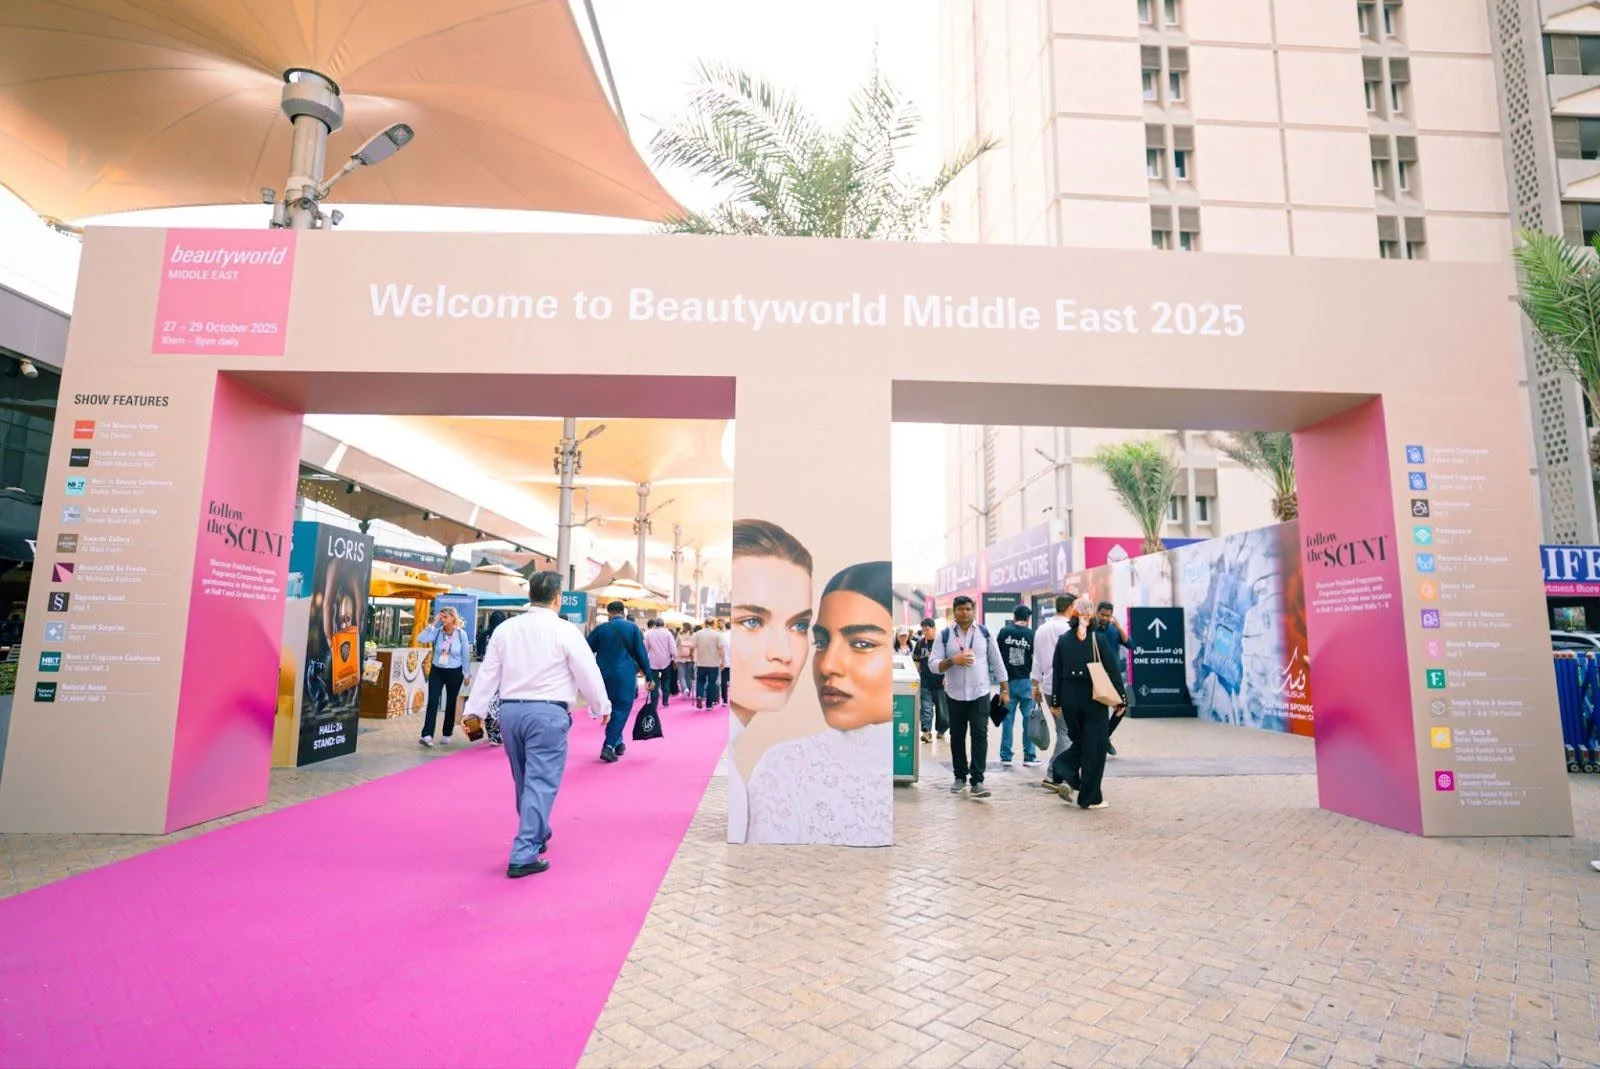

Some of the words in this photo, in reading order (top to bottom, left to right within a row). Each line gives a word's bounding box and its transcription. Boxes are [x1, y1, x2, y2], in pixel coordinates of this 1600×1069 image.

[170, 244, 288, 268] beautyworld
[168, 269, 209, 280] MIDDLE
[211, 270, 239, 280] EAST
[370, 283, 558, 319] Welcome
[573, 290, 612, 320] to
[629, 288, 886, 331] Beautyworld
[904, 294, 1040, 329] Middle
[1056, 298, 1138, 333] East
[1151, 301, 1245, 337] 2025
[162, 321, 177, 332] 27
[189, 322, 202, 332] 29
[206, 321, 247, 333] October
[250, 323, 277, 334] 2025
[162, 335, 185, 345] 10am
[195, 336, 216, 347] 6pm
[218, 336, 239, 347] daily
[74, 394, 110, 405] SHOW
[113, 395, 169, 407] FEATURES
[208, 500, 243, 521] follow
[207, 518, 225, 534] the
[224, 522, 287, 558] SCENT
[328, 535, 365, 562] LORIS
[1306, 532, 1338, 548] follow
[1306, 549, 1323, 563] the
[1322, 534, 1389, 568] SCENT
[1017, 553, 1050, 581] CENTRE
[1542, 548, 1600, 581] IFE
[562, 595, 578, 606] RIS
